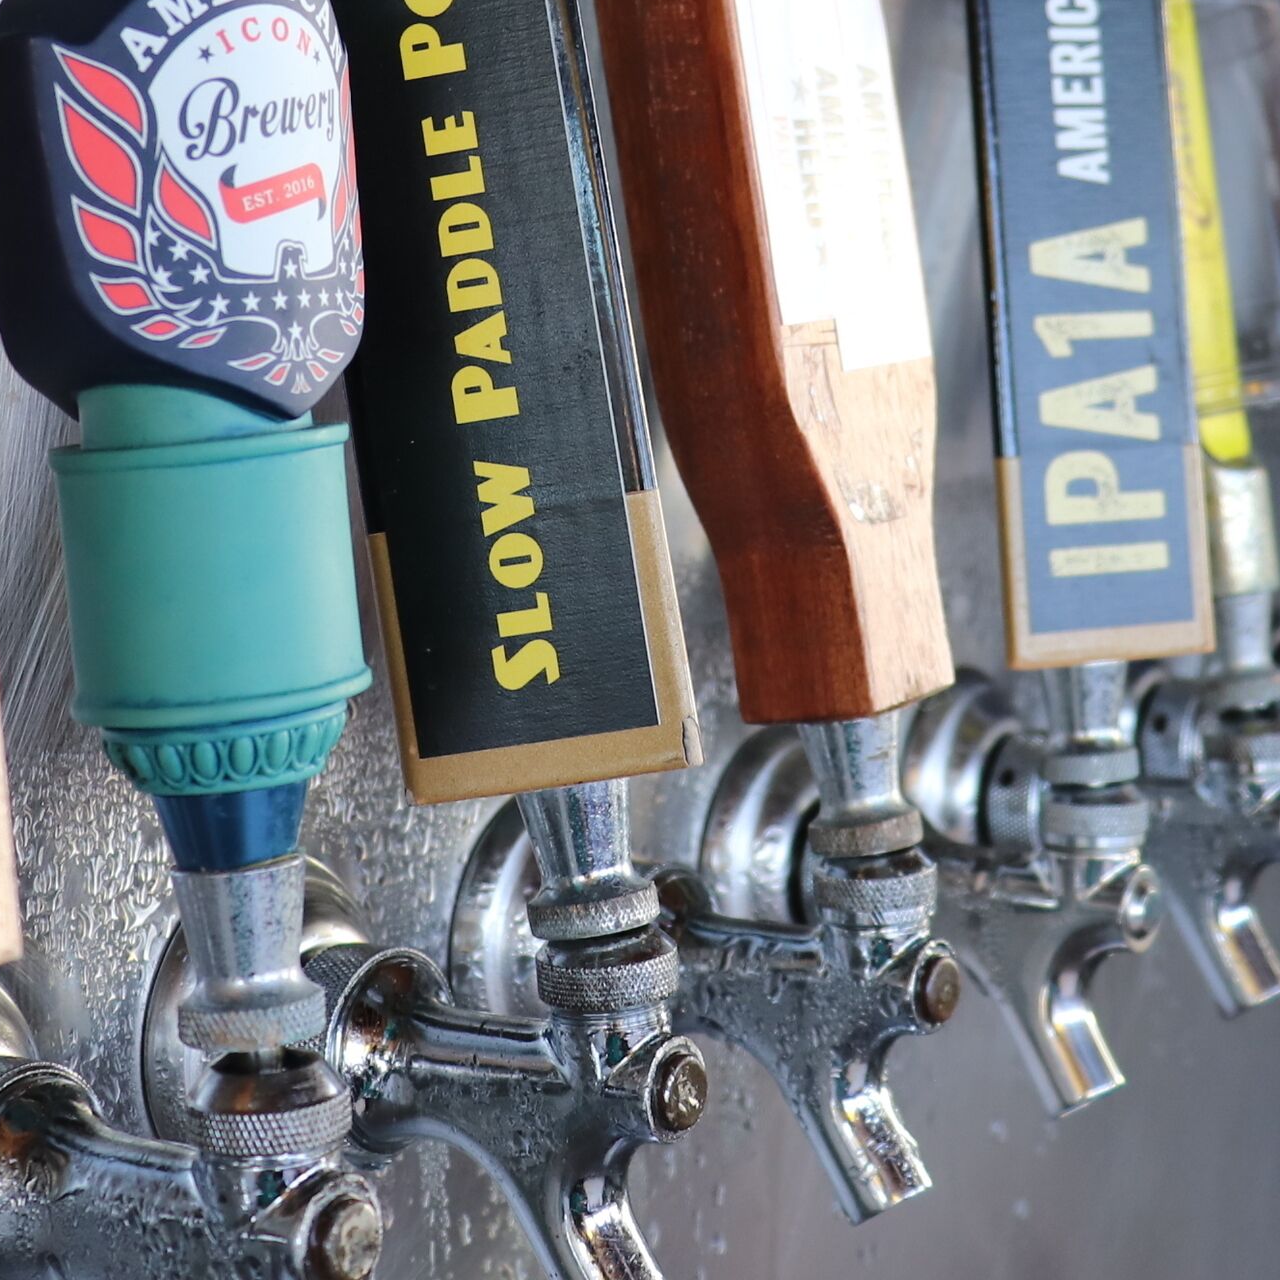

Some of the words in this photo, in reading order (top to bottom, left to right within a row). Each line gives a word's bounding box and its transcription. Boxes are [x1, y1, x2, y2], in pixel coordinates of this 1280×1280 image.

[216, 17, 313, 57] ICON
[178, 77, 335, 161] Brewery
[241, 187, 281, 213] EST.
[283, 175, 316, 199] 2016
[421, 111, 521, 424] PADDLE
[1028, 217, 1170, 578] IPA1A
[472, 460, 561, 691] SLOW
